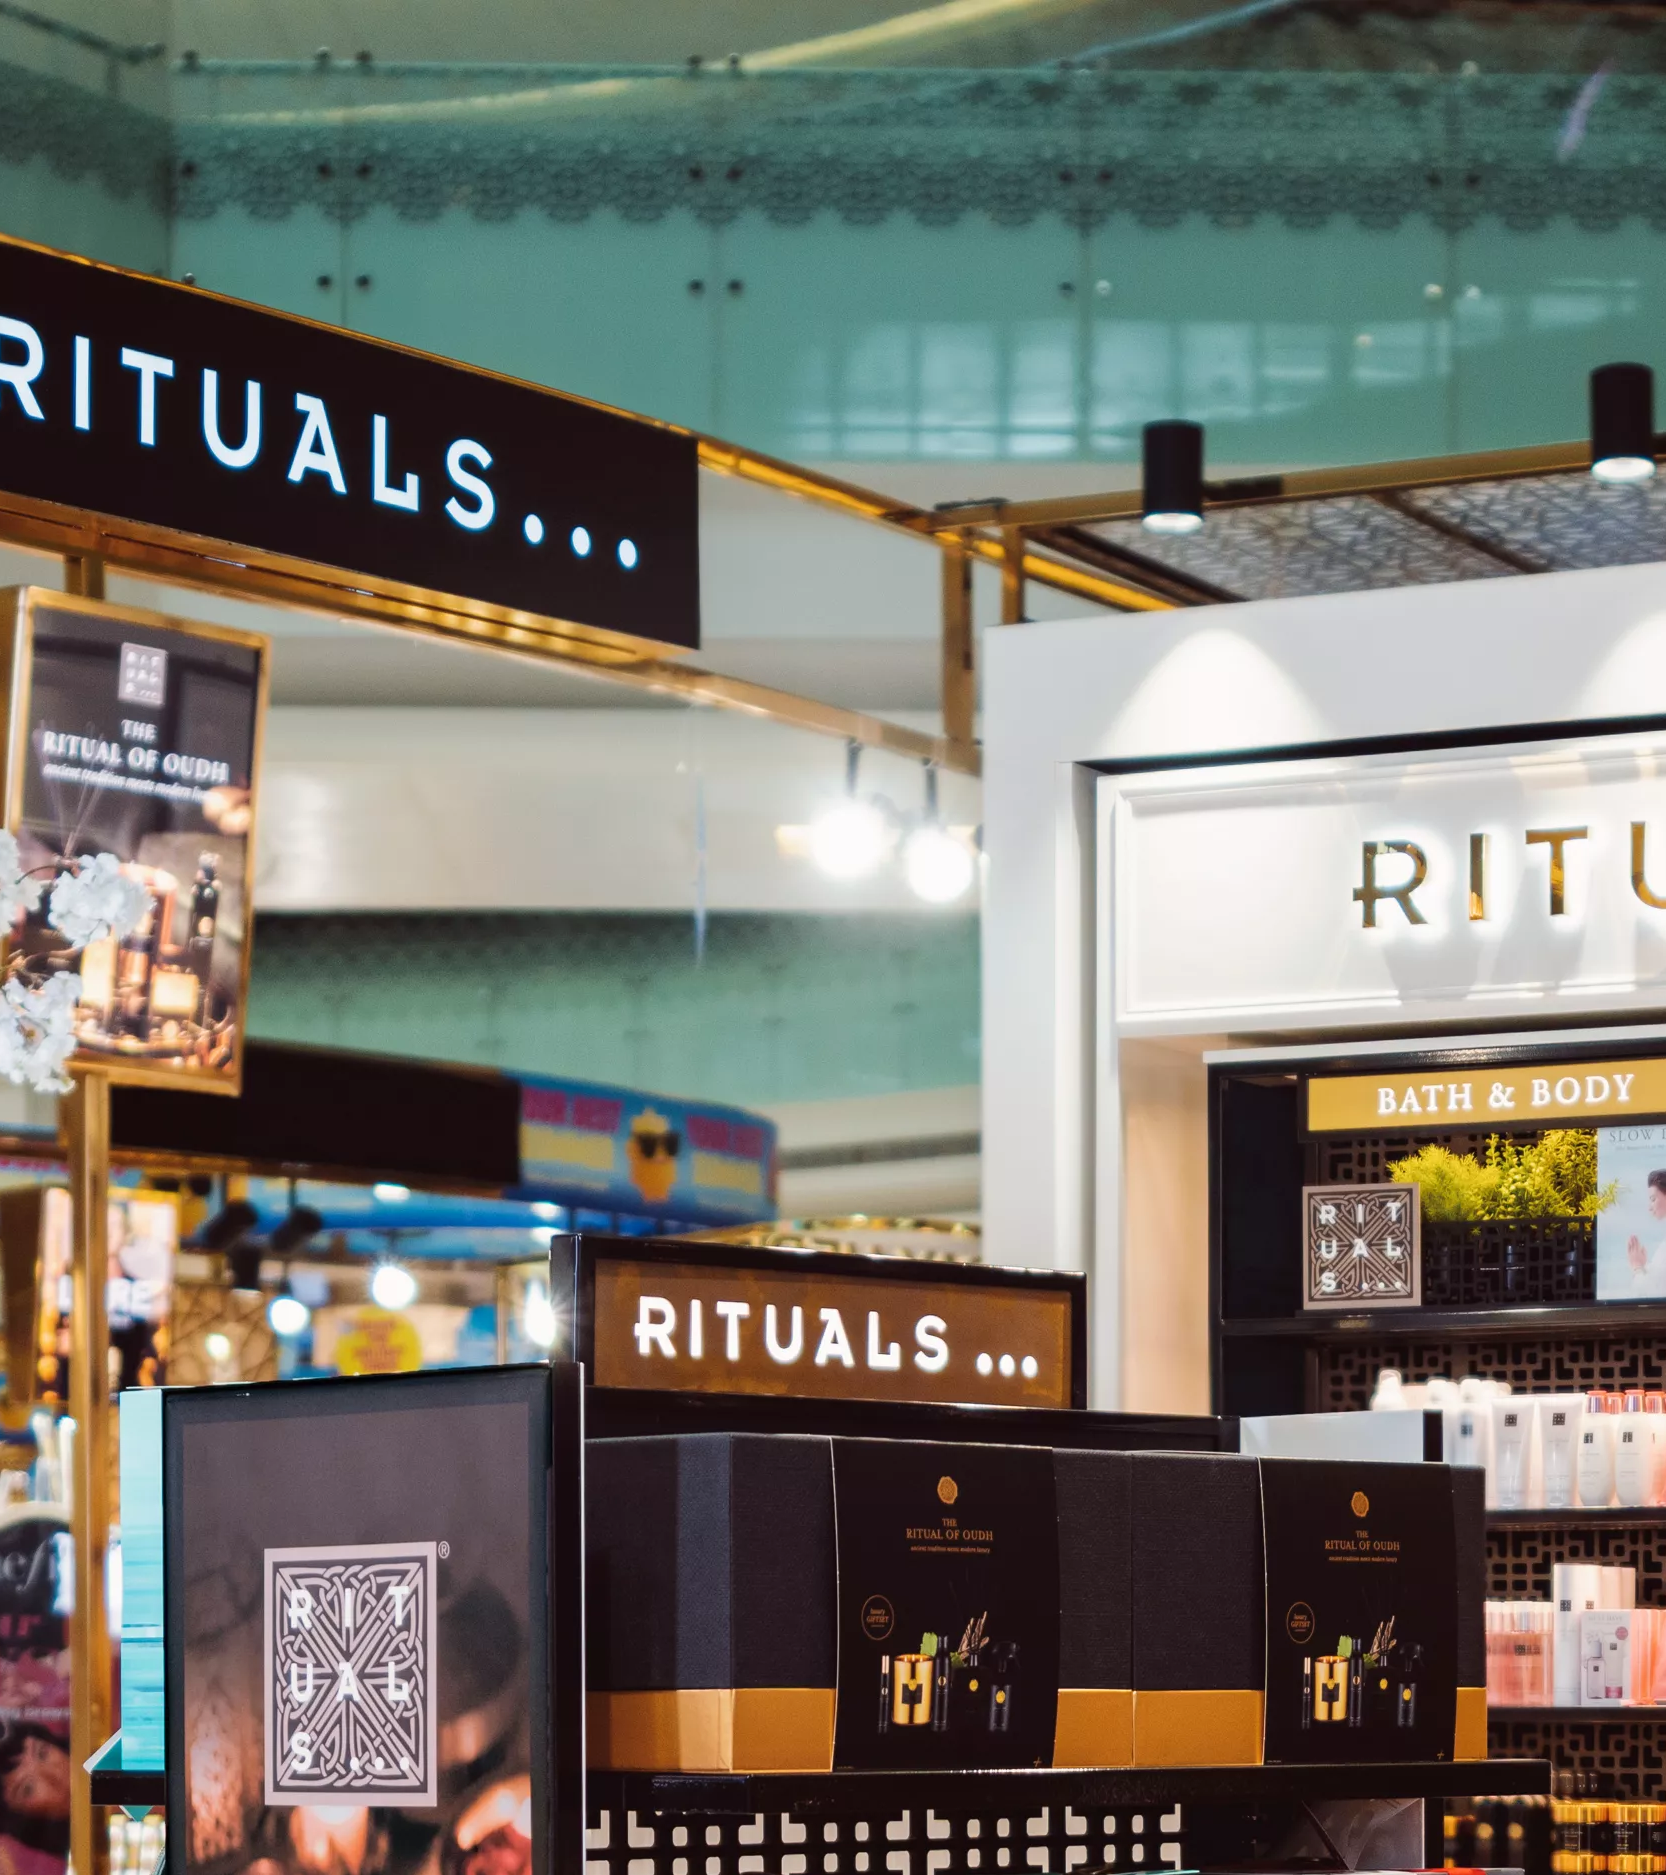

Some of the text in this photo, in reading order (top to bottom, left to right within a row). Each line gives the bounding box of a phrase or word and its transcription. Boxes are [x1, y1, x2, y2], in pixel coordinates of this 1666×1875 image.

[121, 718, 158, 743] THE
[43, 731, 230, 785] RITUAL OF OUDH
[1377, 1073, 1636, 1115] BATH & BODY
[1609, 1127, 1654, 1142] SLOW
[942, 1518, 957, 1527] THE
[906, 1528, 994, 1542] RITUAL OF OUDH
[1355, 1530, 1369, 1538] THE
[1324, 1540, 1400, 1552] RITUAL OF OUDH
